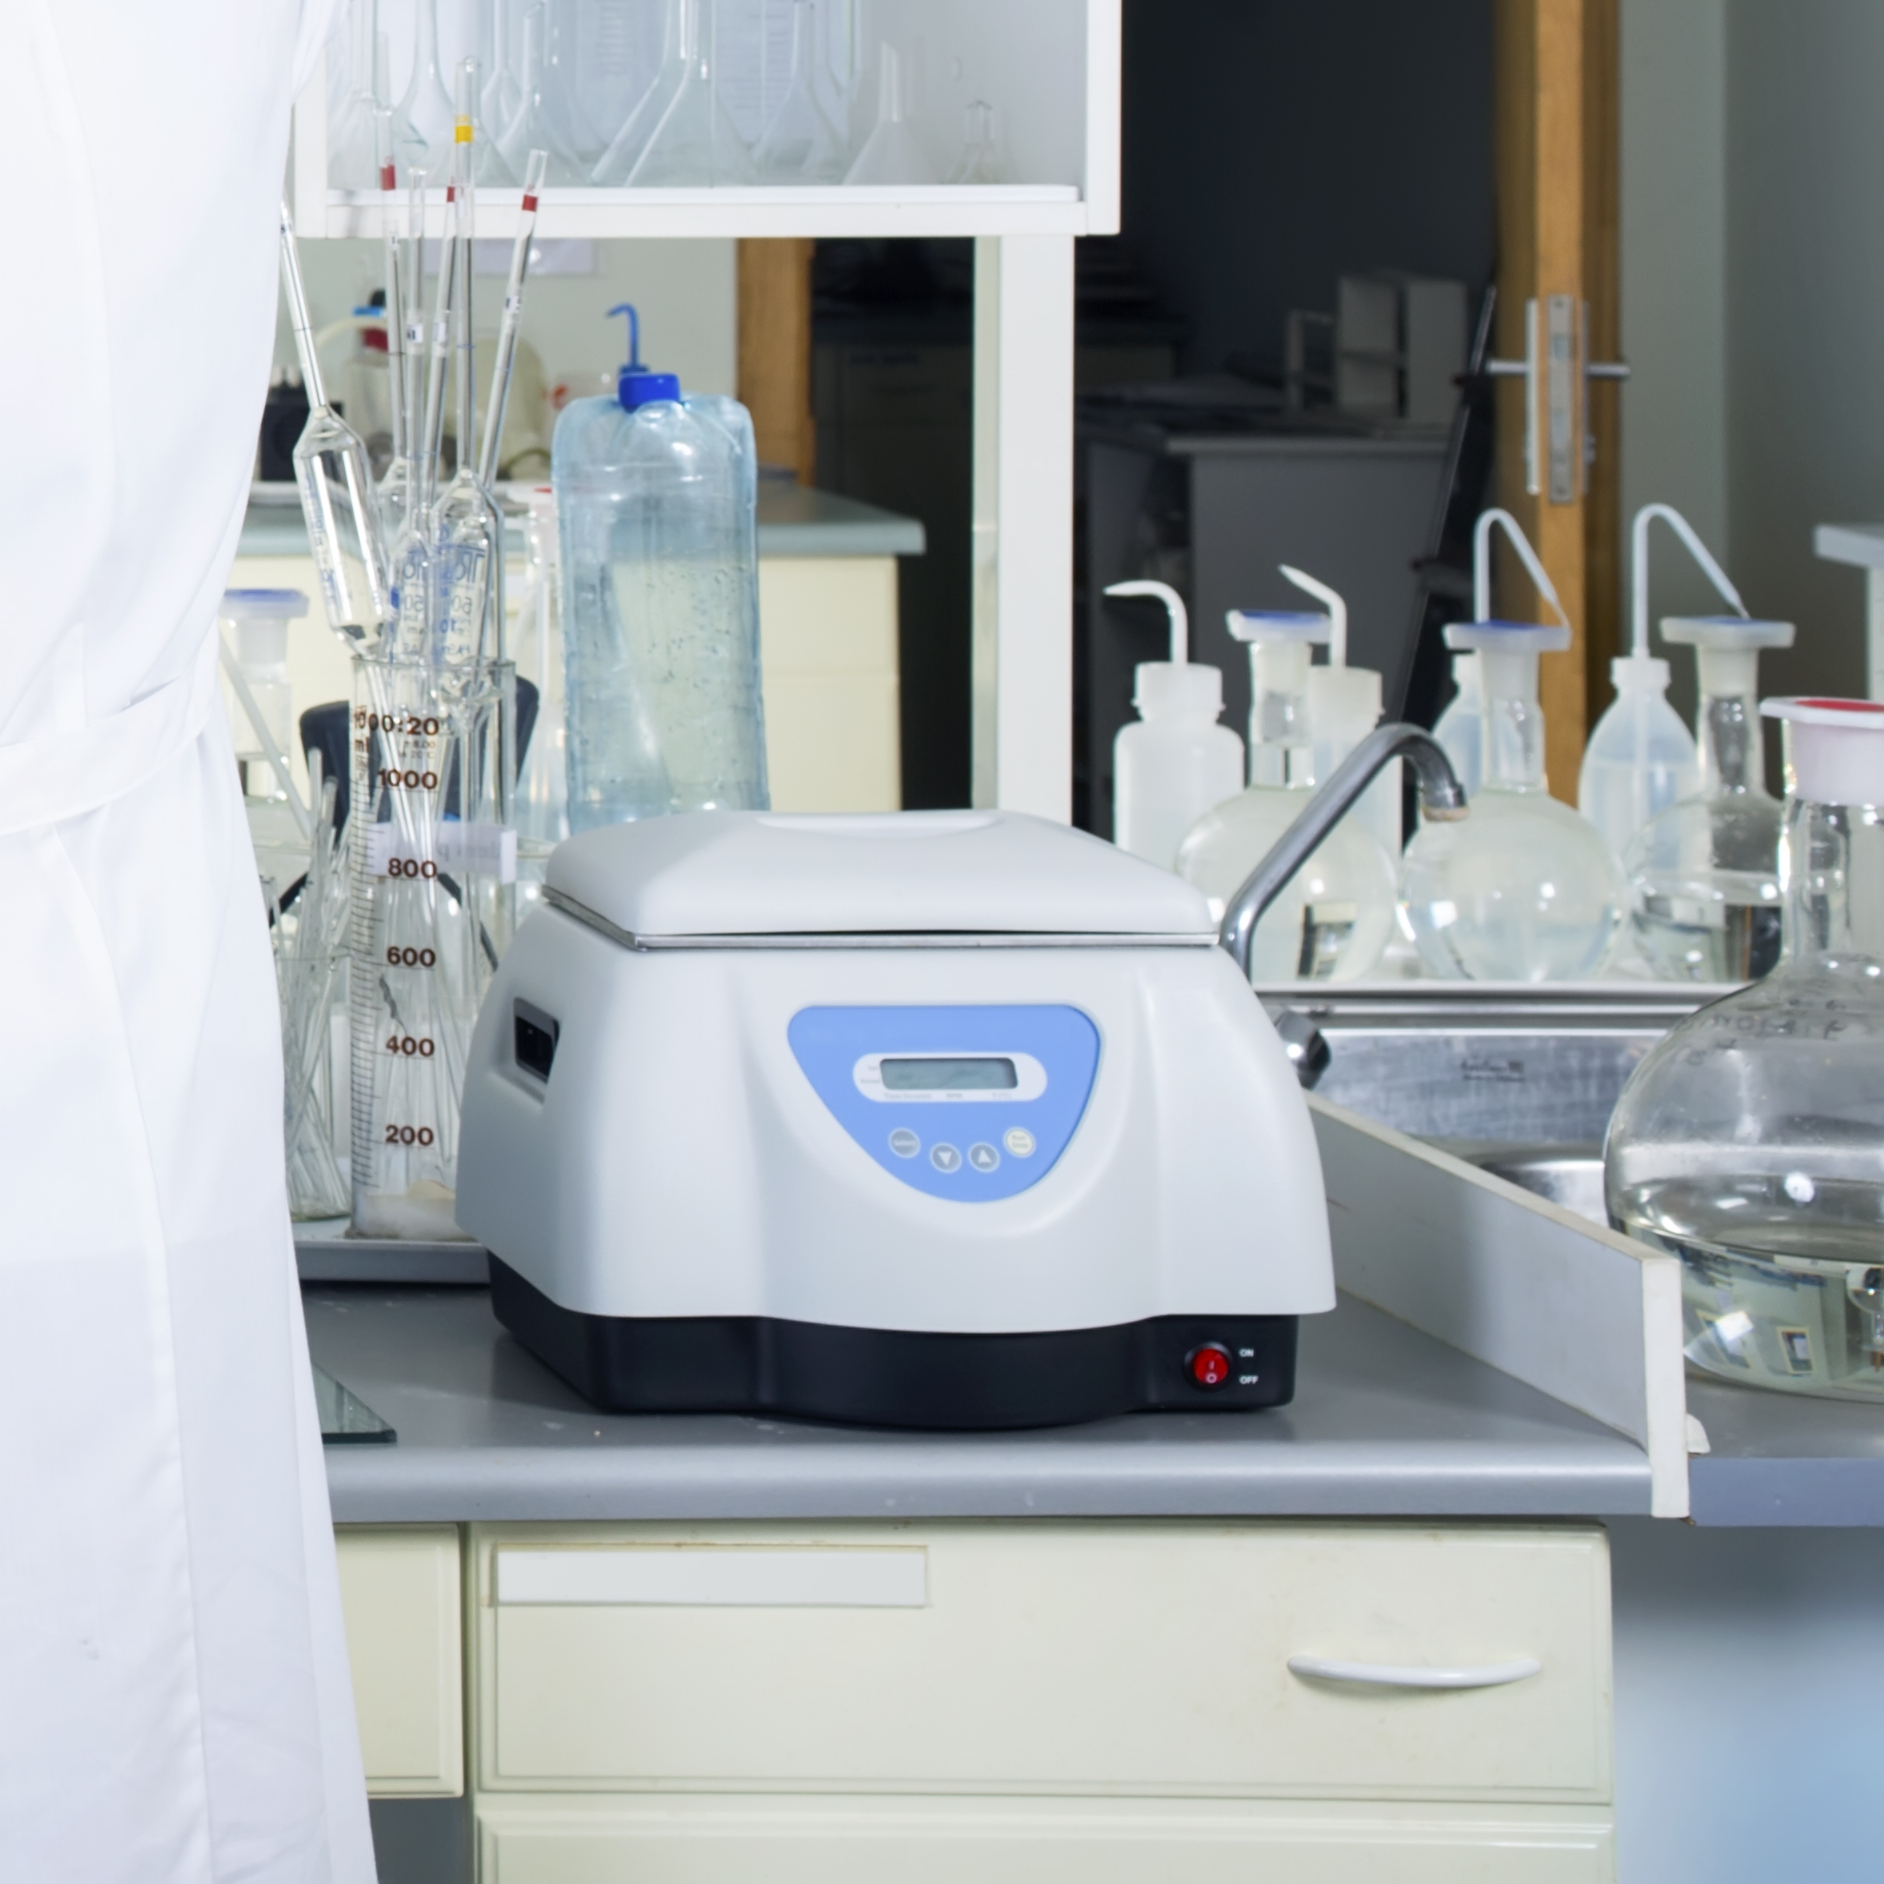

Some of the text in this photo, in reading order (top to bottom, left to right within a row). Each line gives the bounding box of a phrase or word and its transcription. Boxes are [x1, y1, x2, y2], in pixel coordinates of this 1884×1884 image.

[378, 769, 438, 790] 1000
[388, 858, 437, 879] 800
[386, 947, 437, 968] 600
[385, 1036, 436, 1057] 400
[385, 1125, 436, 1146] 200
[1238, 1348, 1255, 1357] ON
[1239, 1375, 1259, 1384] OFF
